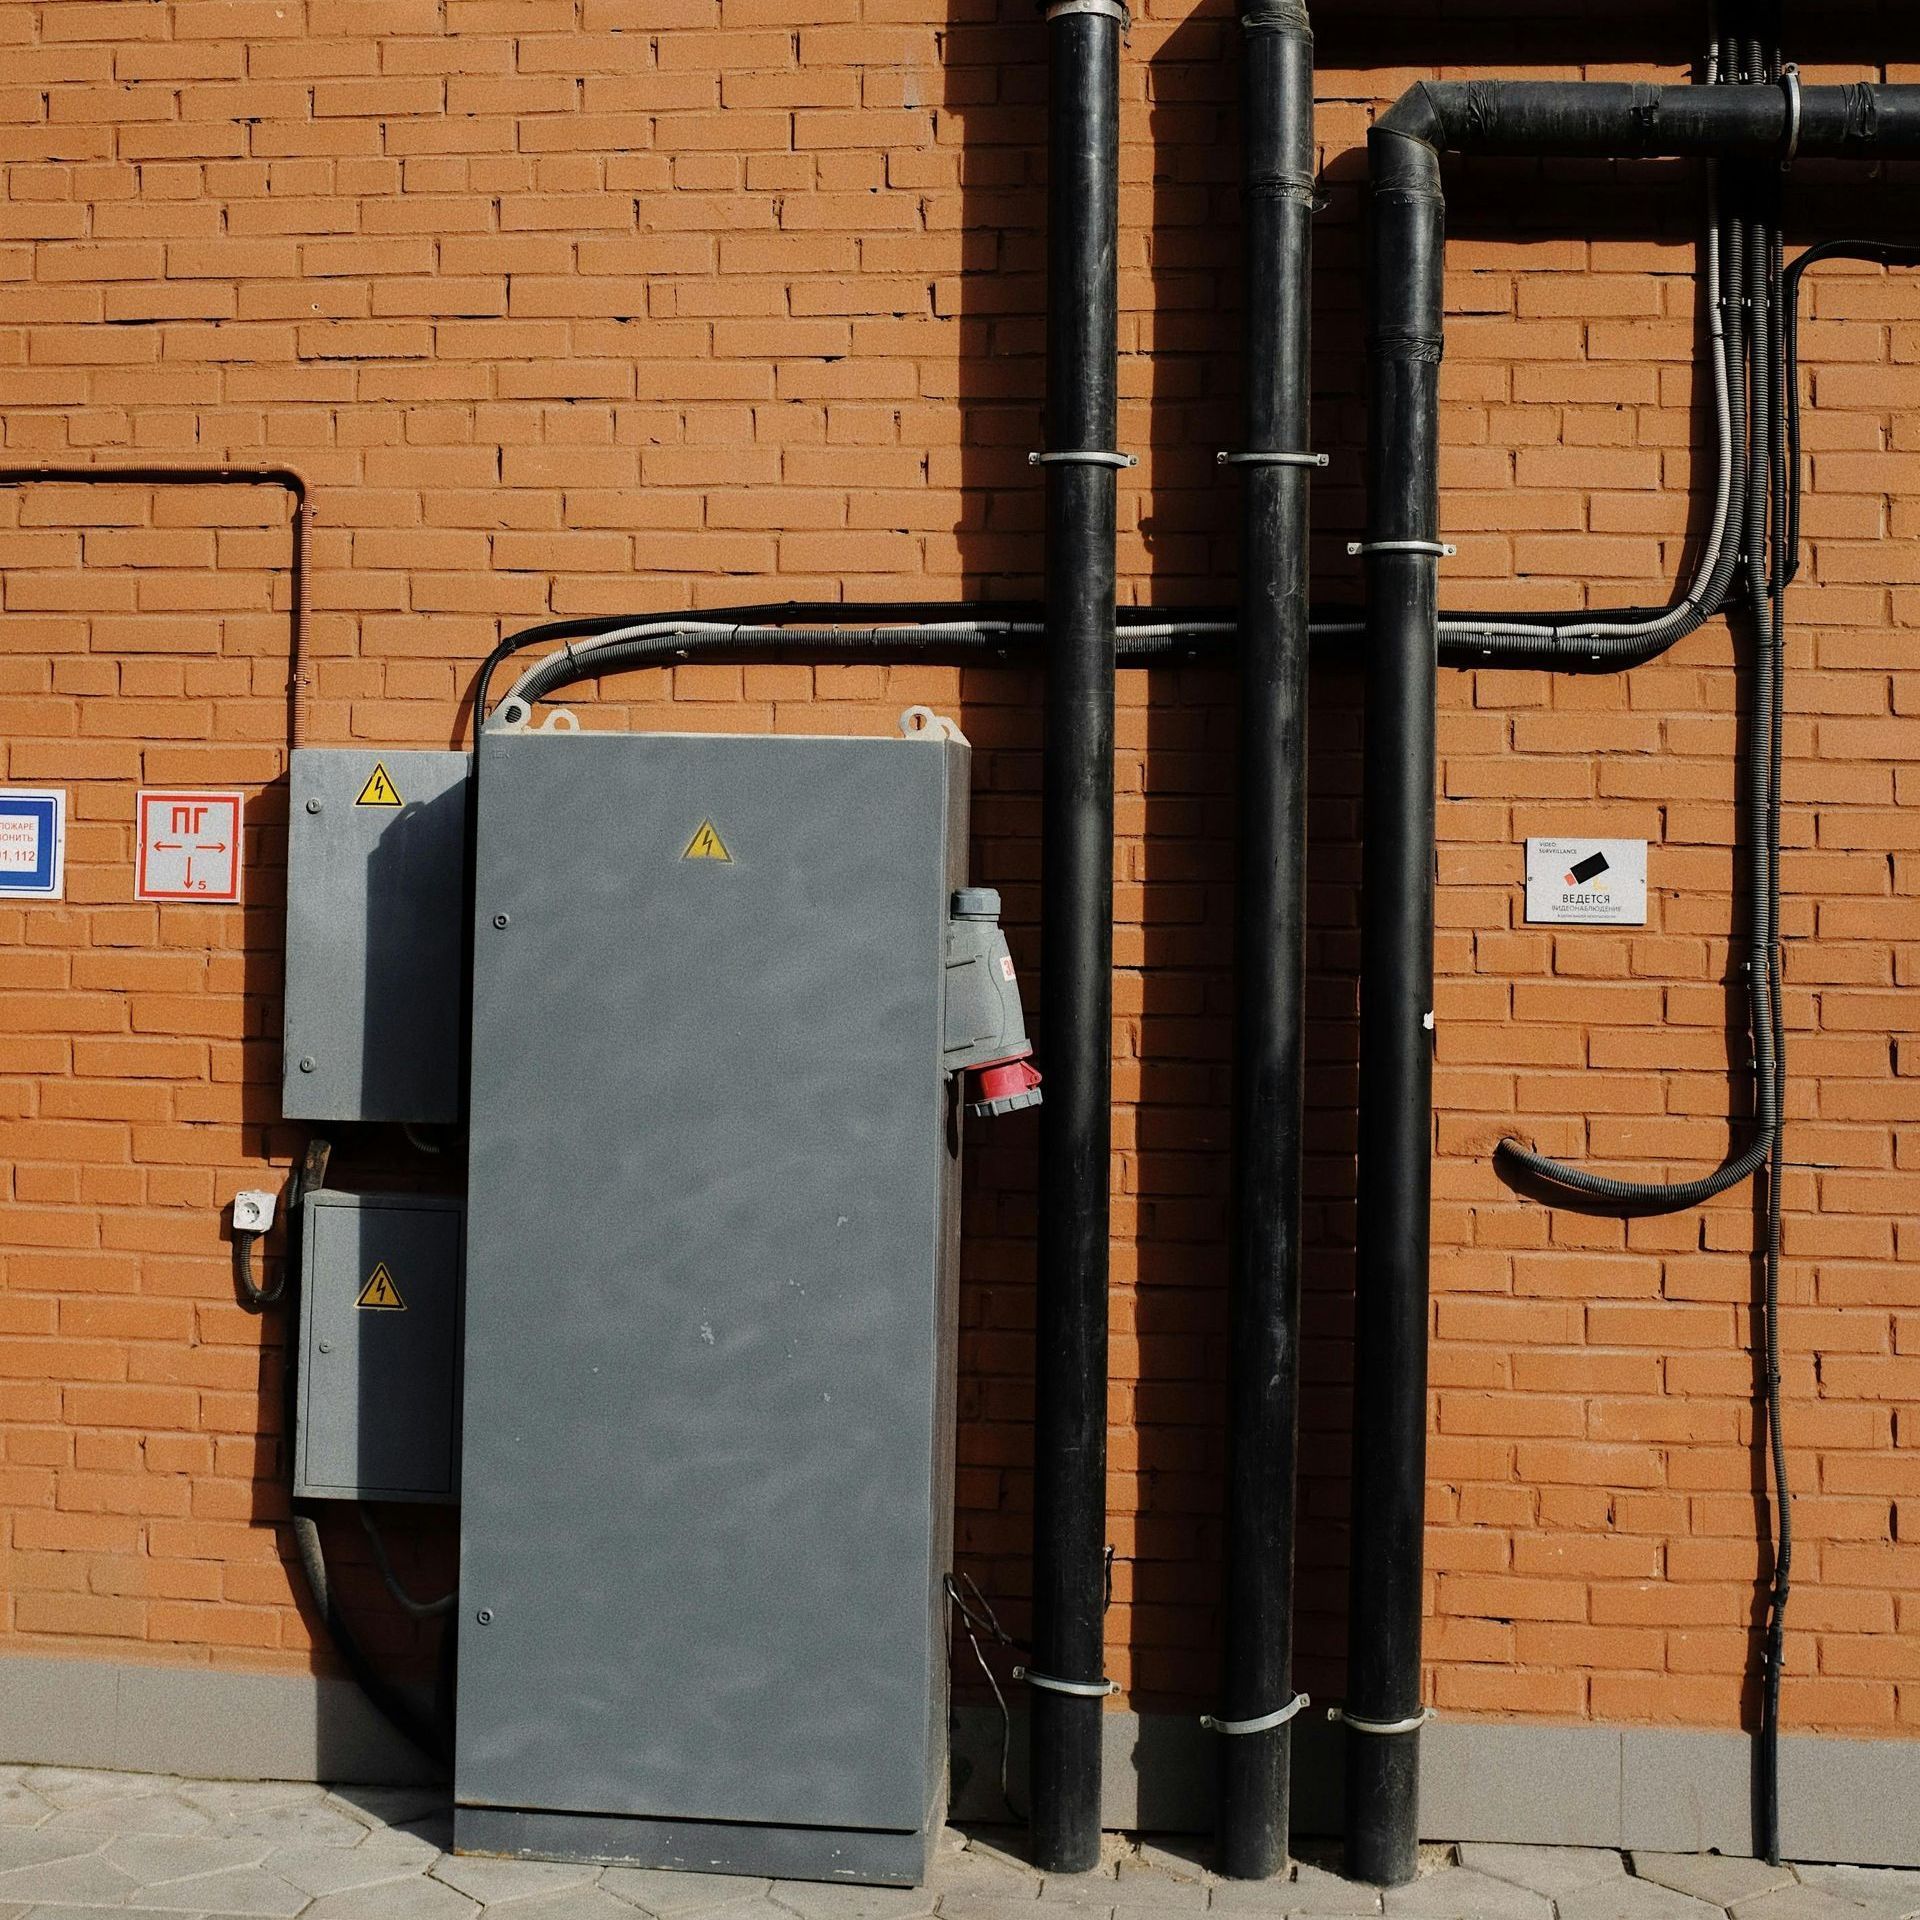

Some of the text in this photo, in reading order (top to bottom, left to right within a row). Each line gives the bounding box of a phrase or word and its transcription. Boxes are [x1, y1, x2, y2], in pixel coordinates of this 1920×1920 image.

[172, 807, 208, 834] ПГ
[0, 834, 34, 842] ОНИТЬ
[0, 850, 36, 863] 1, 112
[198, 881, 207, 890] 5
[1562, 894, 1610, 904] ВЕДЕТСЯ
[1552, 905, 1622, 913] ВИДЕОНАБЛЮДЕНИЕ
